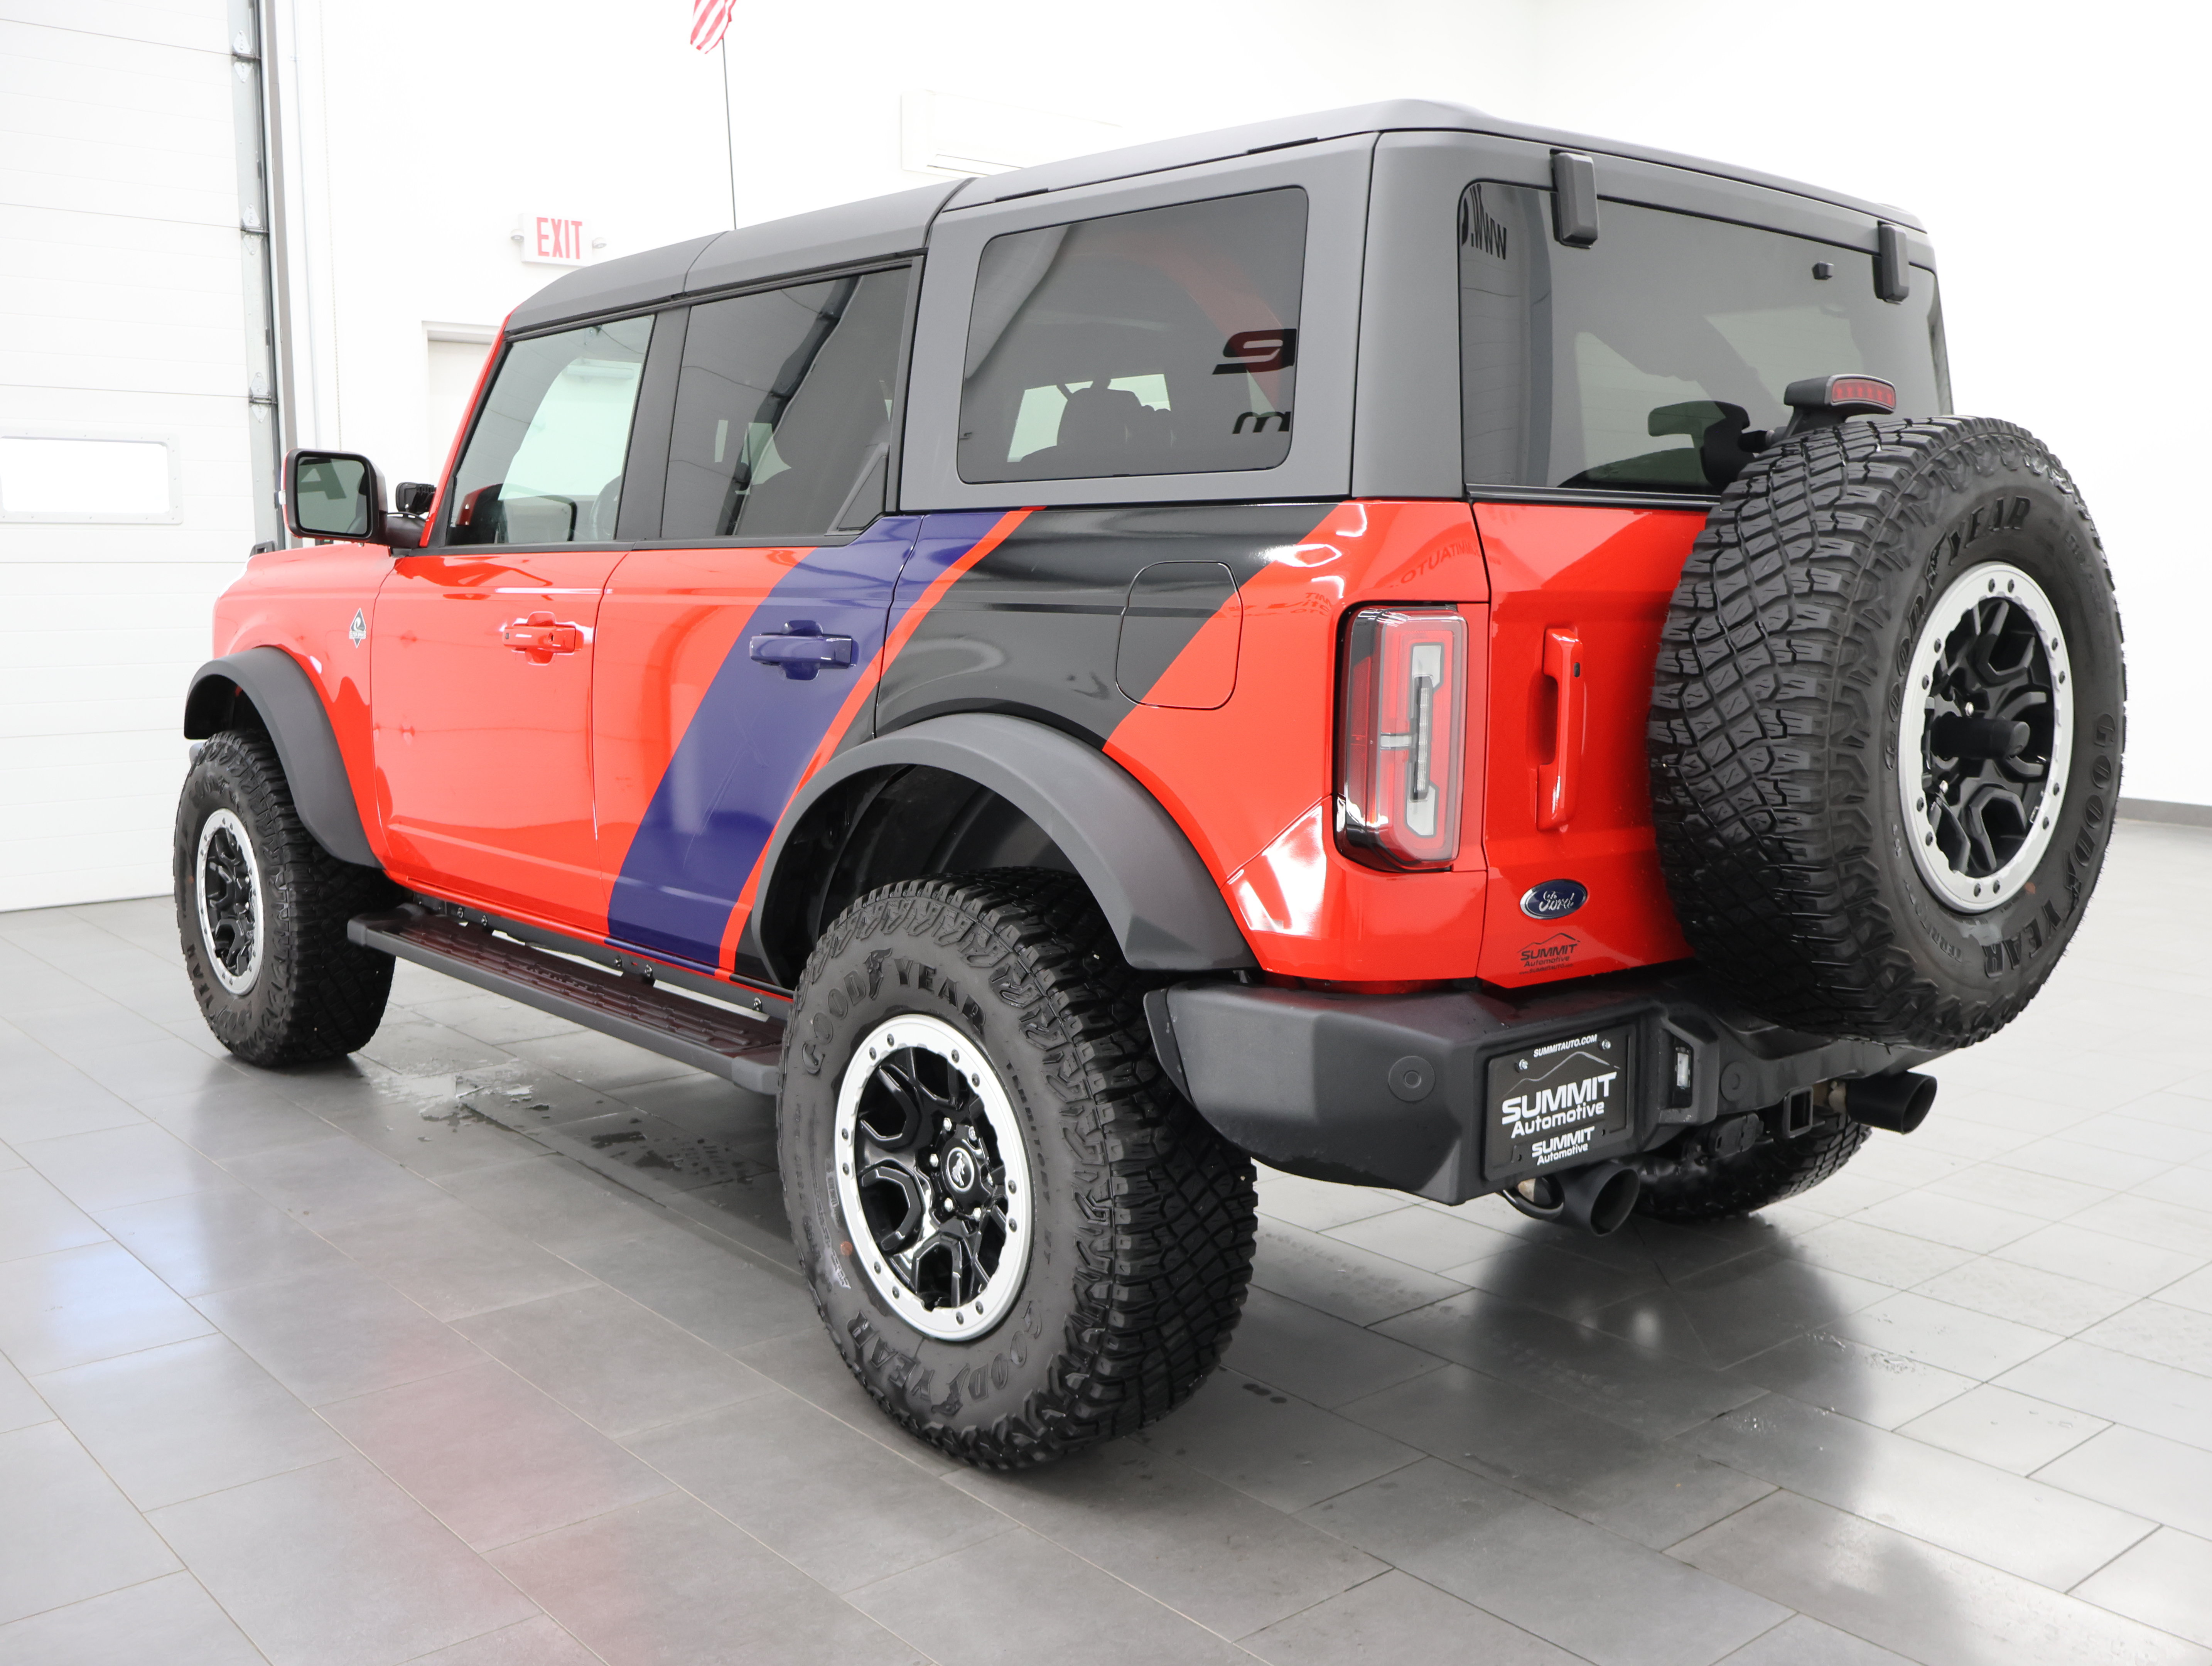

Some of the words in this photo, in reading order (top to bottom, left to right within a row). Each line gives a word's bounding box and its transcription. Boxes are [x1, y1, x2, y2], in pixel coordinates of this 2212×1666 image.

[537, 217, 582, 260] EXIT
[1539, 890, 1575, 912] Ford
[1520, 944, 1578, 961] SUMMIT
[1524, 956, 1570, 967] Automotive
[801, 948, 987, 1074] GOODYEAR
[1533, 1034, 1597, 1058] SUMMITAUTO.COM
[1502, 1071, 1617, 1125] SUMMIT
[1511, 1101, 1605, 1138] Automotive
[1531, 1126, 1595, 1158] SUMMIT
[1537, 1143, 1588, 1165] Automotive
